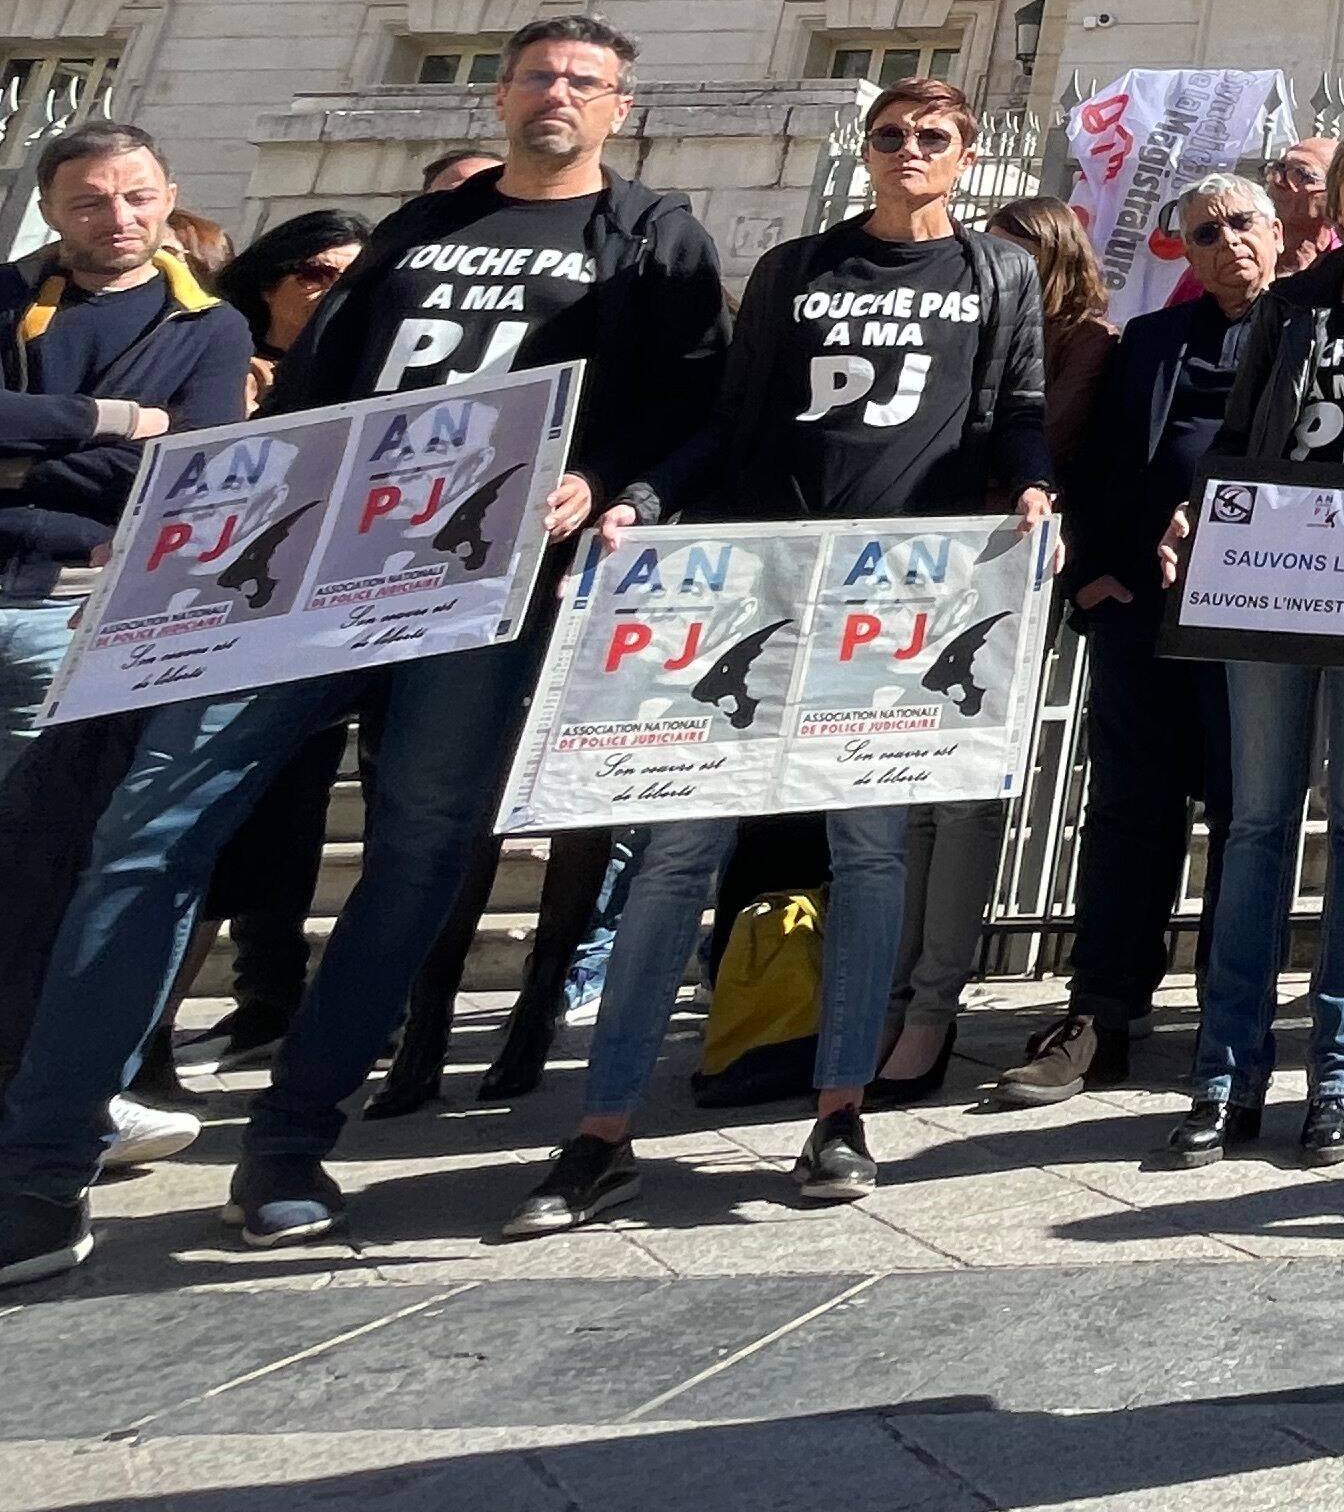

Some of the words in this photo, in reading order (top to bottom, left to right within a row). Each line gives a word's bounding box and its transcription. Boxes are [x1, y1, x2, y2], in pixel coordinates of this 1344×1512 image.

[1103, 109, 1199, 291] Magistrature
[395, 244, 534, 276] TOUCHE
[529, 249, 597, 284] PAS
[421, 282, 454, 310] A
[460, 285, 526, 312] MA
[793, 287, 916, 323] TOUCHE
[918, 291, 980, 323] PAS
[823, 321, 851, 347] A
[861, 321, 924, 347] MA
[374, 318, 530, 392] PJ
[795, 352, 932, 428] PJ
[1223, 549, 1328, 572] SAUVONS
[1189, 591, 1269, 610] SAUVONS
[562, 721, 640, 736] ASSOCIATION
[644, 718, 708, 732] NATIONALE
[801, 724, 815, 735] DE
[820, 722, 864, 734] POLICE
[868, 718, 936, 732] JUDICIAIRE
[803, 709, 877, 723] ASSOCIATION
[880, 706, 940, 719] NATIONALE
[558, 738, 574, 750] DE
[580, 735, 626, 748] POLICE
[630, 730, 704, 746] JUDICIAIRE
